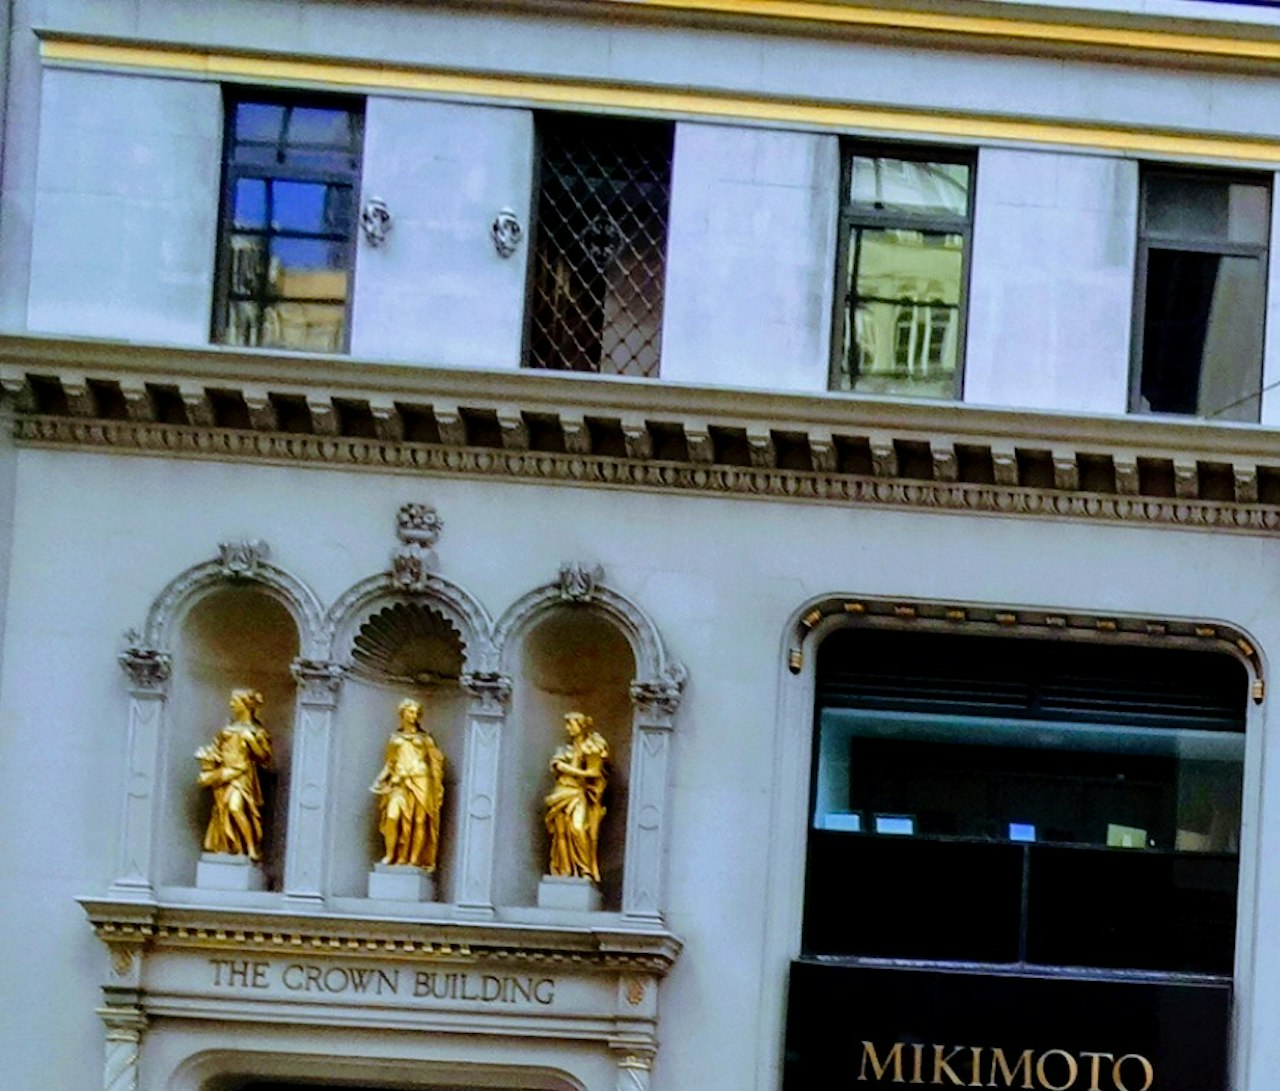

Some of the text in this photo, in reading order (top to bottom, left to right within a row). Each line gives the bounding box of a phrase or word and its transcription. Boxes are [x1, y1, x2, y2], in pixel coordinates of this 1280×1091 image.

[210, 959, 555, 1005] THE CROWN BUILDING
